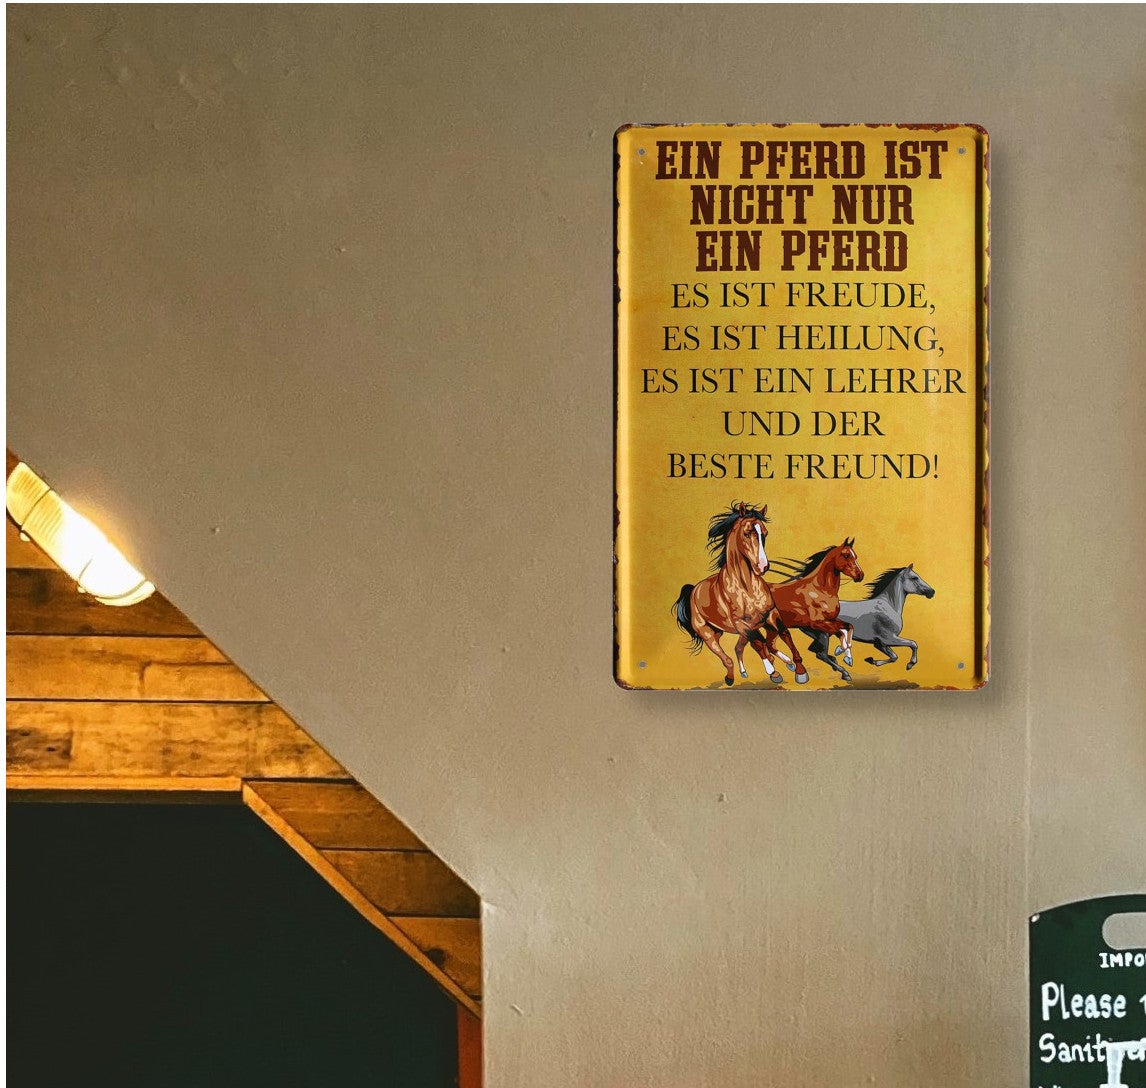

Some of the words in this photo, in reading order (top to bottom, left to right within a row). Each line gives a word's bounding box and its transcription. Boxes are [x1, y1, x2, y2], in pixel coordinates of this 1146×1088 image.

[655, 140, 722, 180] EIN
[739, 140, 866, 180] PFERD
[883, 140, 949, 180] IST
[689, 184, 814, 225] NICHT
[831, 184, 915, 225] NUR
[695, 230, 763, 272] EIN
[780, 230, 909, 272] PFERD
[670, 282, 710, 309] ES
[719, 282, 776, 308] IST
[784, 281, 936, 315] FREUDE,
[661, 325, 700, 352] ES
[710, 325, 766, 351] IST
[775, 325, 945, 358] HEILUNG,
[640, 368, 679, 394] ES
[688, 368, 744, 394] IST
[755, 368, 815, 394] EIN
[823, 367, 967, 395] LEHRER
[721, 410, 801, 437] UND
[810, 410, 886, 437] DER
[666, 452, 775, 479] BESTE
[784, 453, 940, 480] FREUND!
[1041, 981, 1127, 1021] Please
